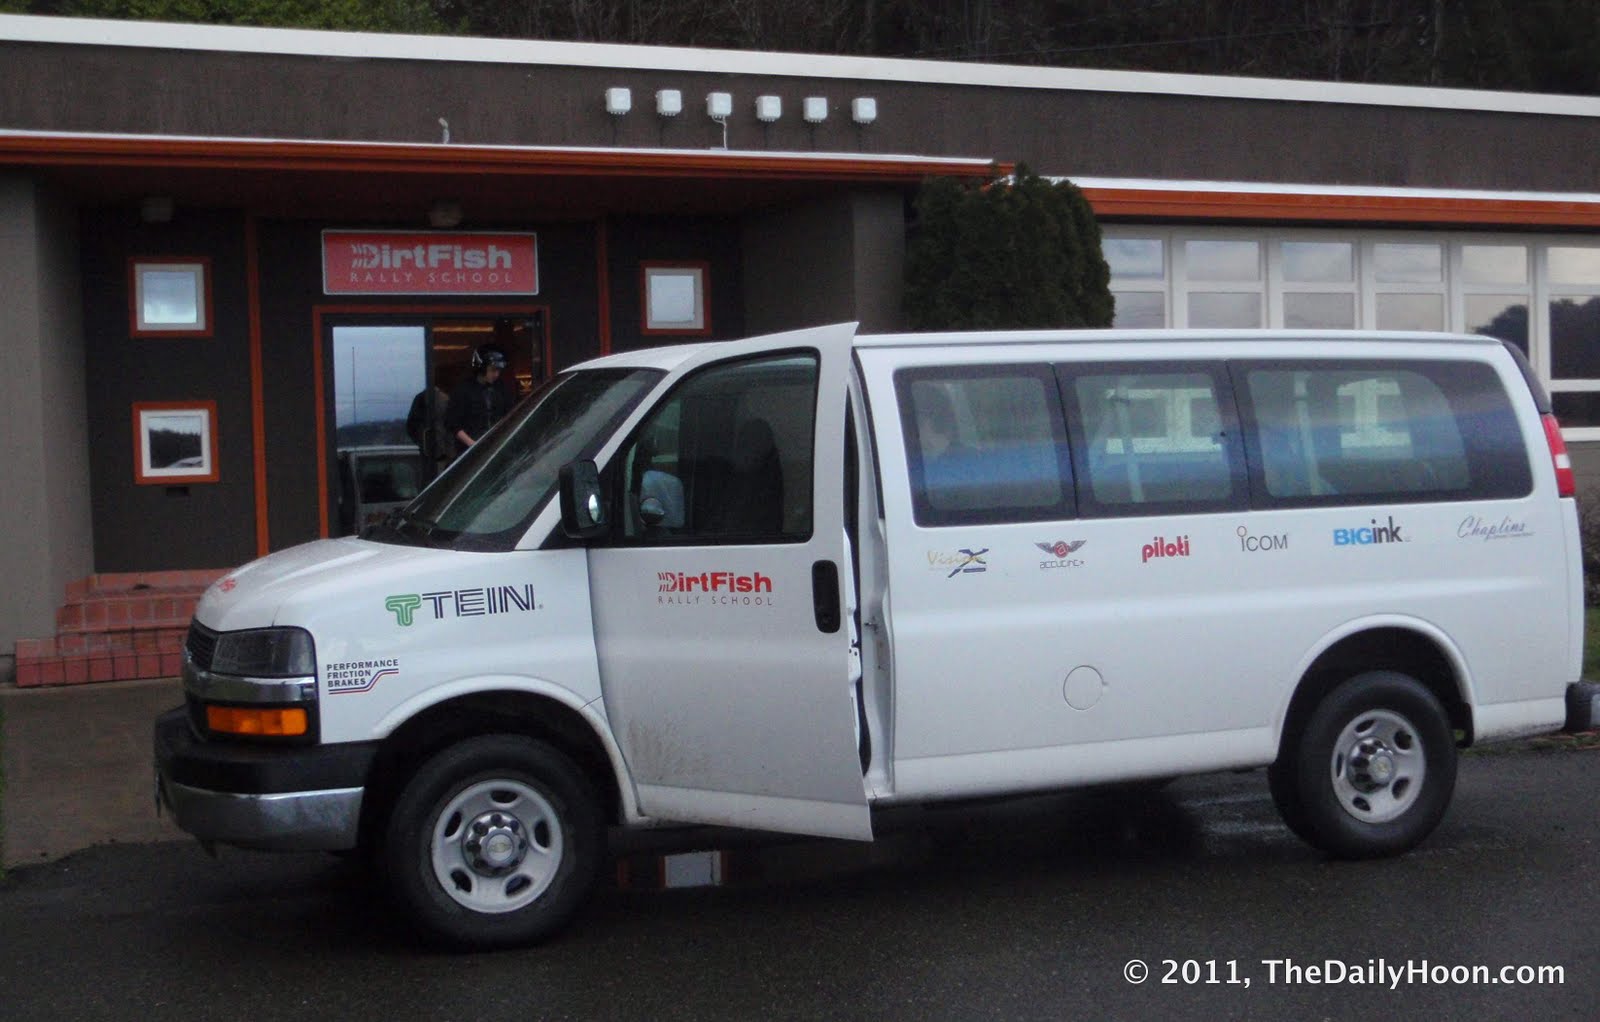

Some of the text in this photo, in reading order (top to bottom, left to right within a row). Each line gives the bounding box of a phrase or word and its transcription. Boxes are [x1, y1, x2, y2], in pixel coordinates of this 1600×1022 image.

[351, 243, 513, 269] DirtFish
[350, 272, 512, 283] RALLY SCHOOL
[1333, 516, 1403, 546] BIGink
[1142, 535, 1190, 563] piloti
[657, 571, 772, 593] DirtFish
[422, 584, 536, 619] TEIN
[658, 595, 773, 606] RALLY SCHOOL
[326, 659, 399, 671] PERFORMANCE
[327, 669, 372, 680] FRICTION
[327, 678, 367, 688] BRAKES
